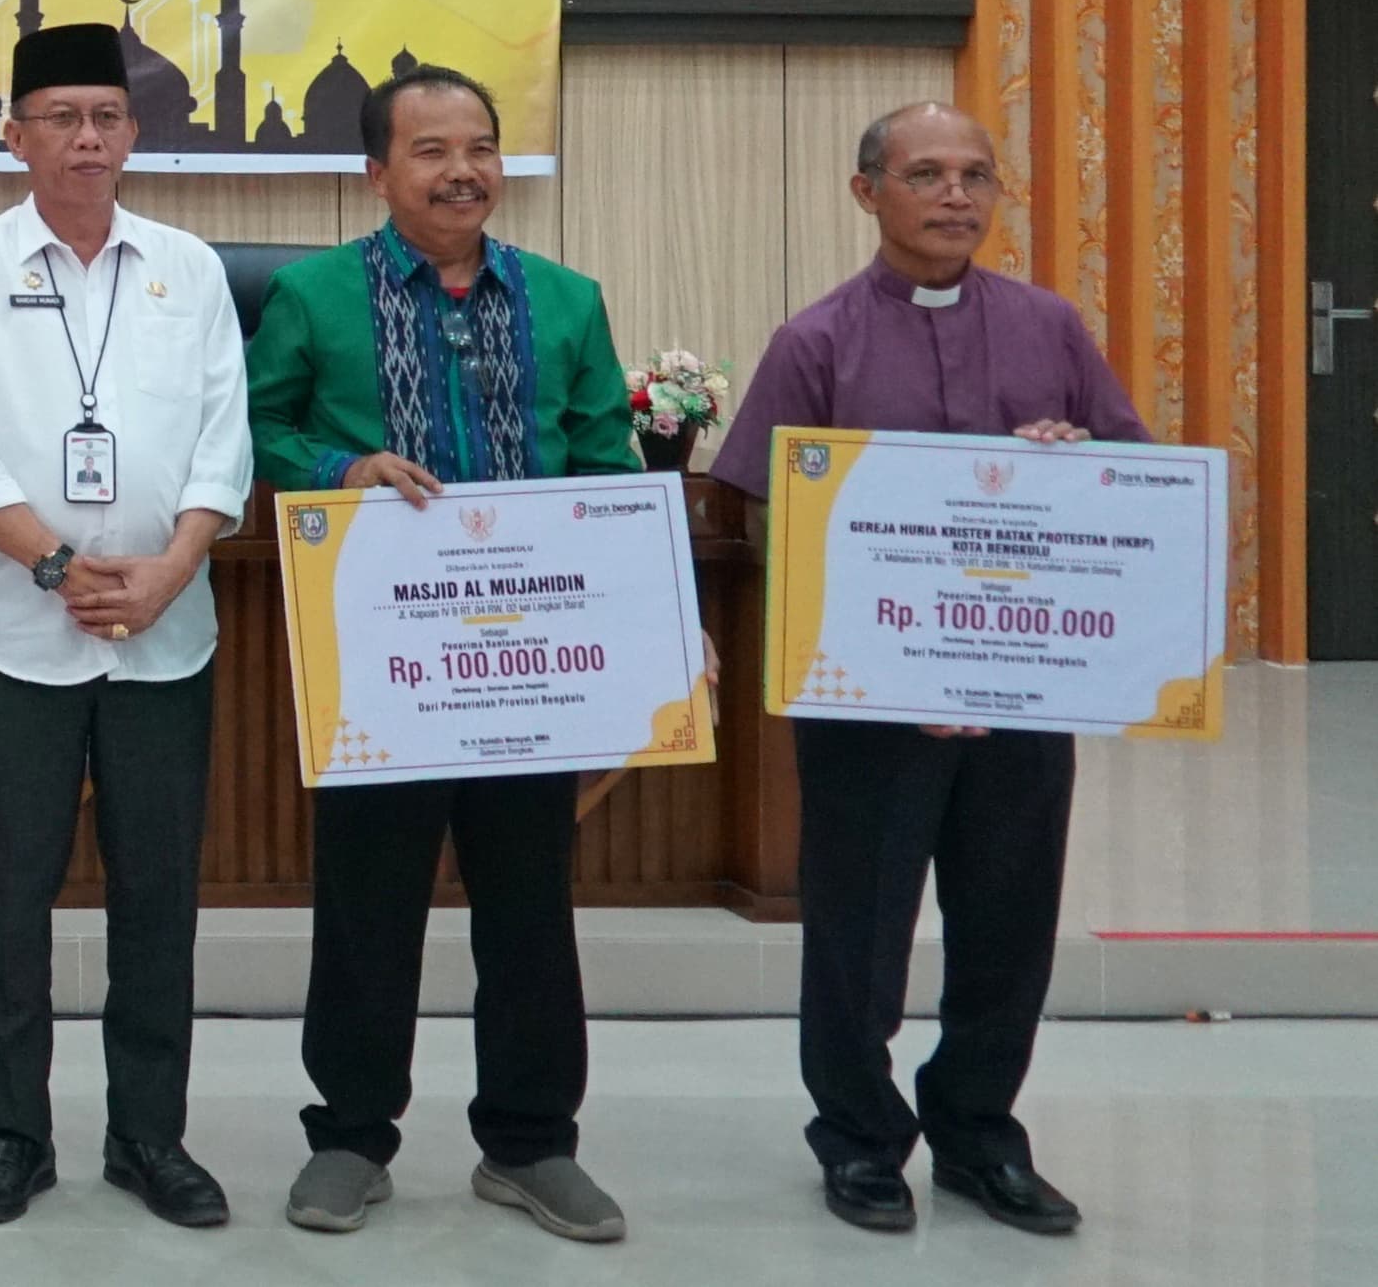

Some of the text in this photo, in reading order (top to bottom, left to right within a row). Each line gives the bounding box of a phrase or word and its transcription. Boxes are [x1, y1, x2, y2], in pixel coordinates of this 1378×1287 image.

[393, 574, 585, 601] MASJID AL MUJAHIDIN
[876, 597, 1115, 639] Rp. 100.000.000
[388, 643, 606, 689] Rp. 100.000.000
